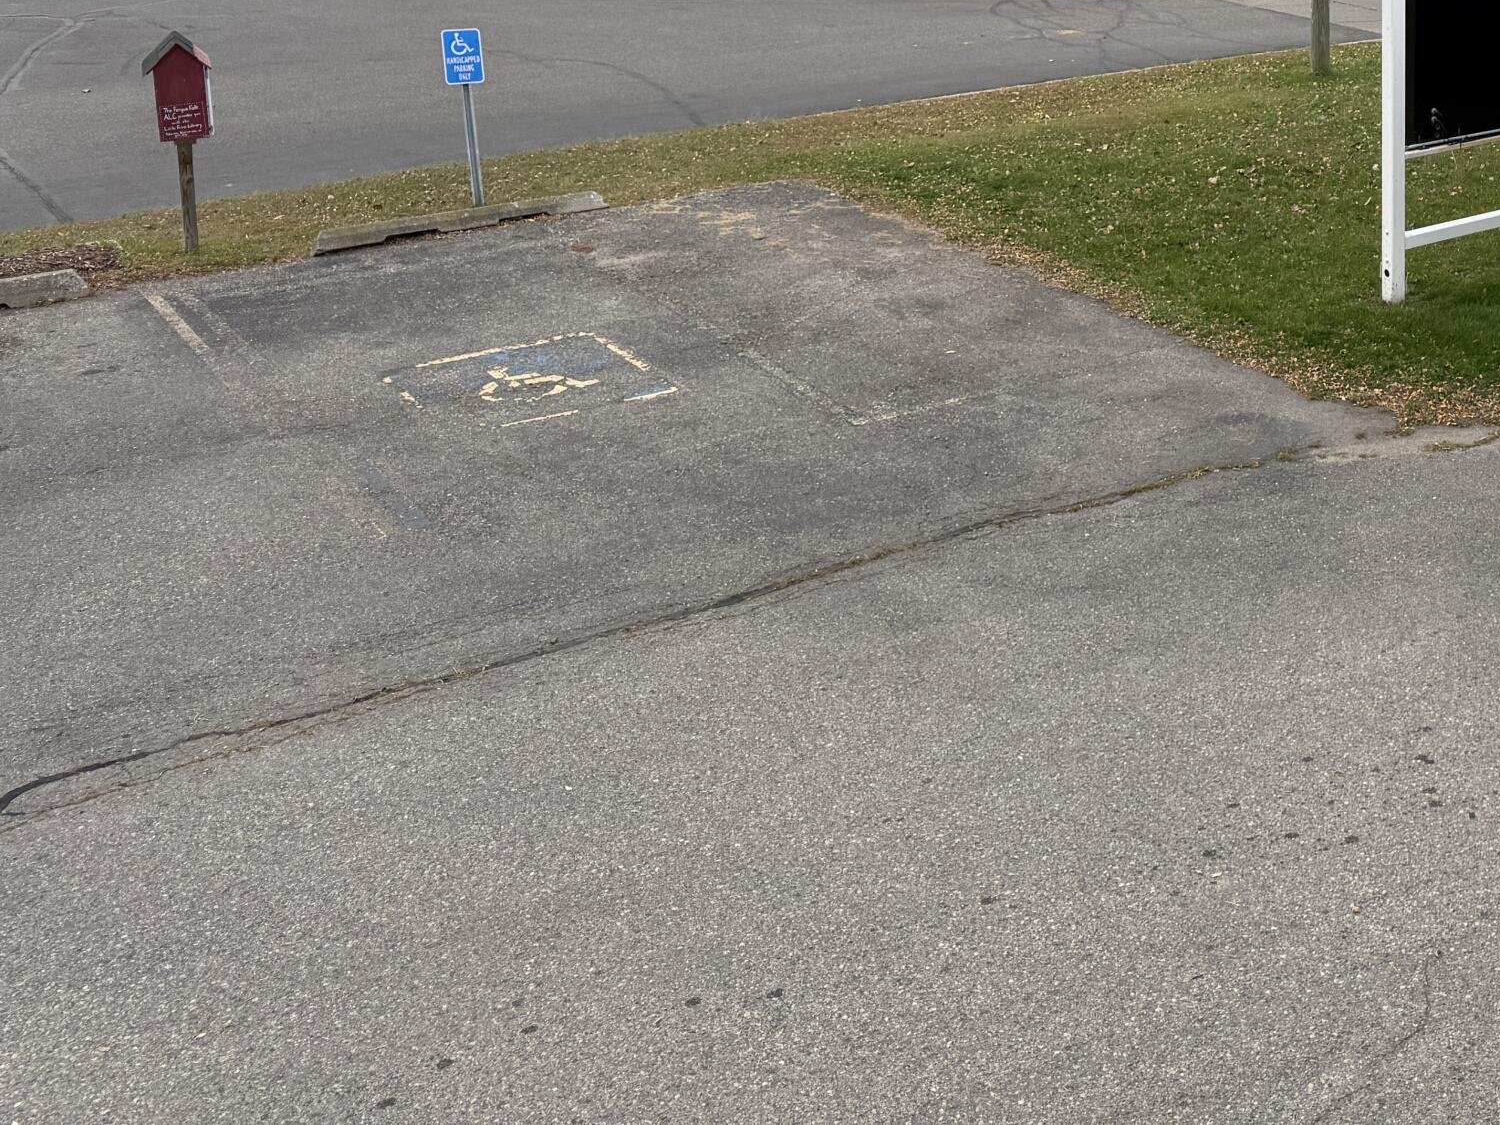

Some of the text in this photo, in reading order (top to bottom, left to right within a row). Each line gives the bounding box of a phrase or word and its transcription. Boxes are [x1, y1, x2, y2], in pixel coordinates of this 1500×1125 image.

[447, 56, 480, 64] HANDICAPPED
[454, 64, 474, 72] PARKING
[458, 73, 471, 81] ONLY
